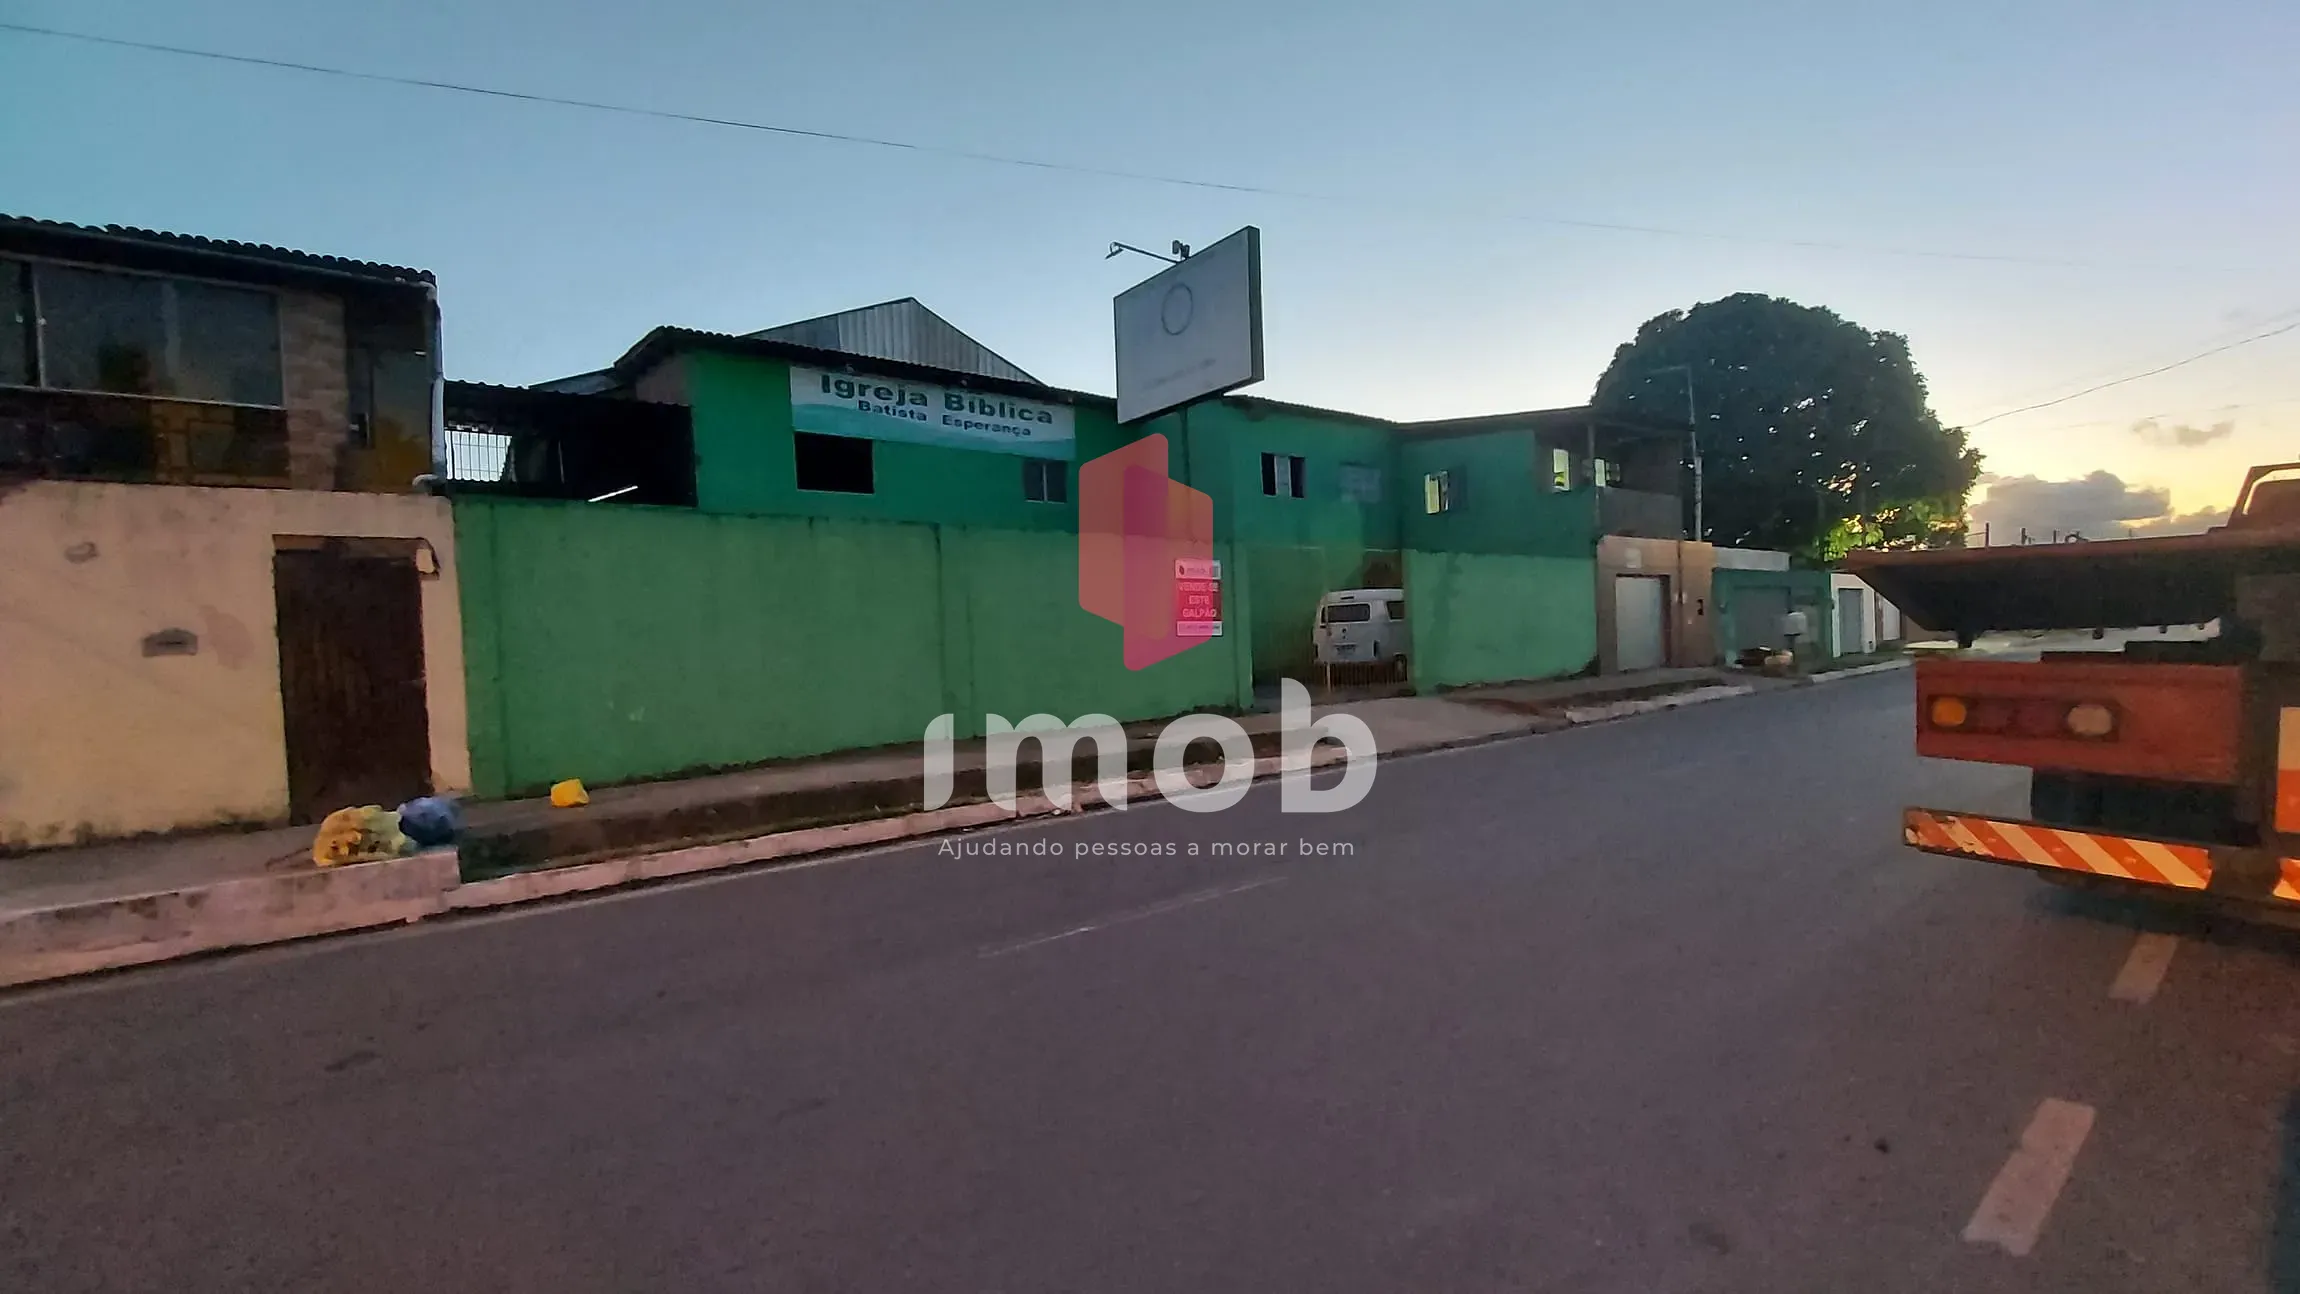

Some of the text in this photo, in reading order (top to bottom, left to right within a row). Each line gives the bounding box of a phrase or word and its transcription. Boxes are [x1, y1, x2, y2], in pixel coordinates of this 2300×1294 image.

[821, 374, 928, 406] Igreja
[858, 400, 1032, 437] Batista Esperança
[1189, 595, 1210, 605] ESTE
